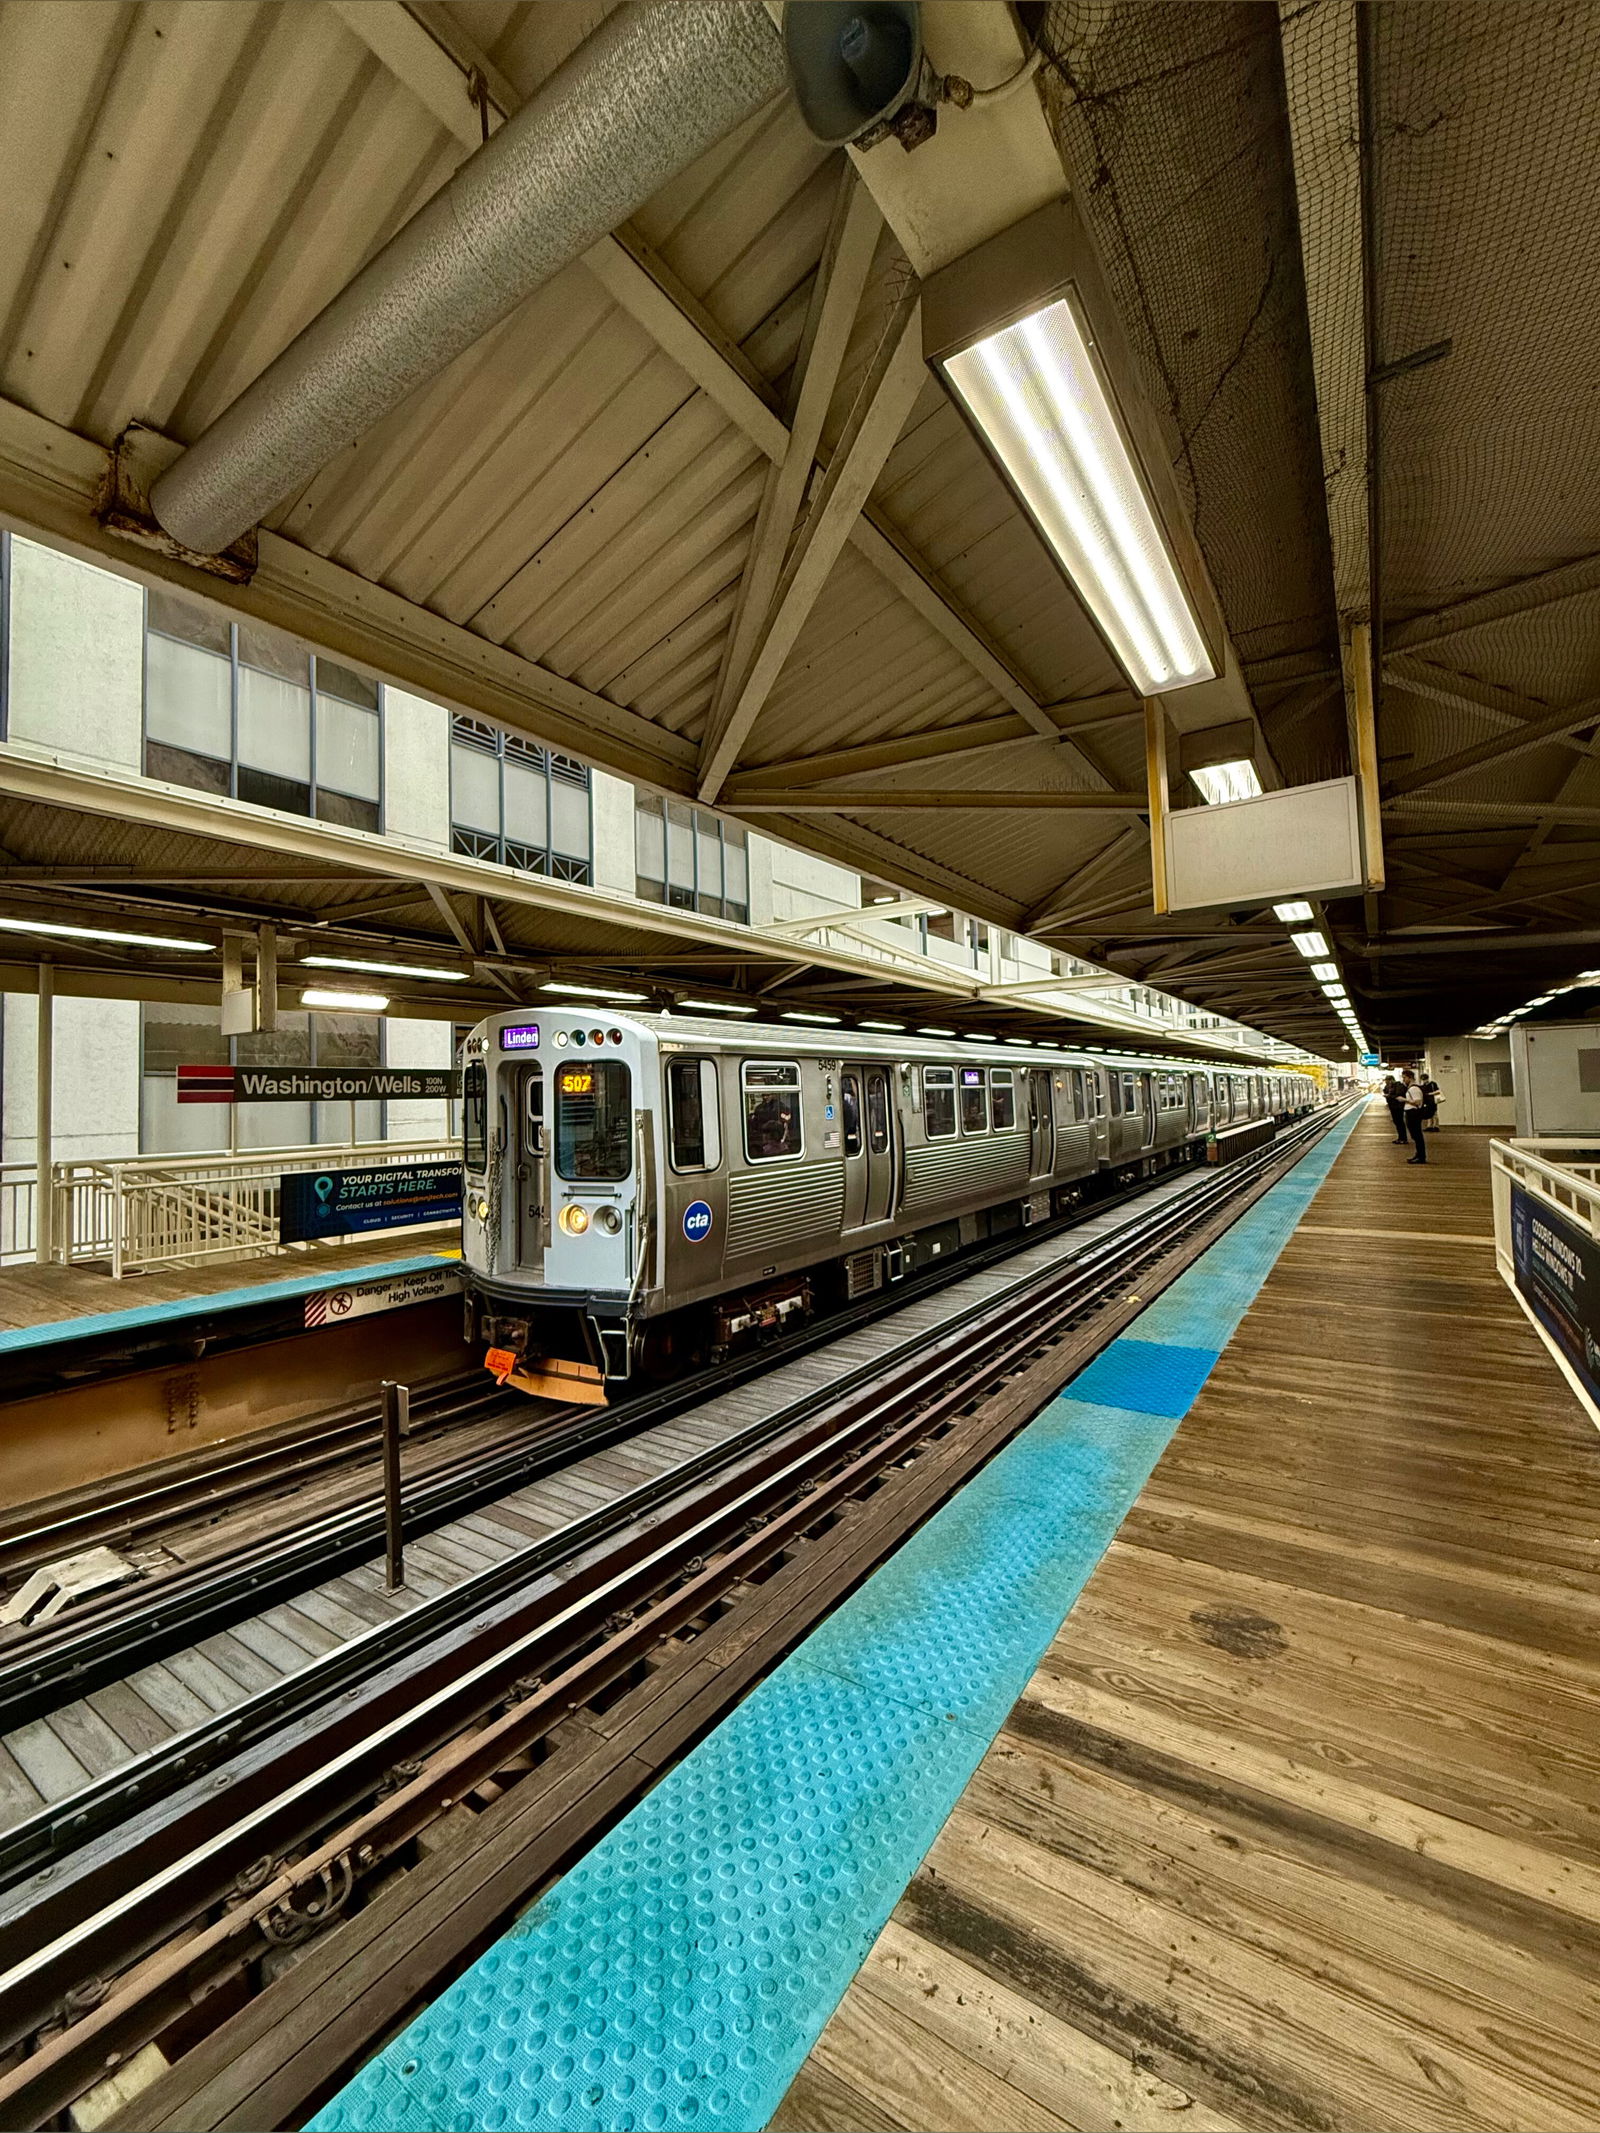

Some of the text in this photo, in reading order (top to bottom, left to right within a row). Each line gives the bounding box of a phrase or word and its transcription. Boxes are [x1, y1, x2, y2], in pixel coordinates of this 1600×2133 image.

[507, 1030, 538, 1045] Linden
[818, 1059, 836, 1071] 5459
[242, 1074, 422, 1099] Washington/Wells
[425, 1077, 443, 1085] 100N
[562, 1075, 592, 1092] 507
[424, 1085, 447, 1094] 200W
[1208, 1134, 1215, 1143] 2
[342, 1174, 372, 1185] YOUR
[374, 1171, 414, 1183] DIGITAL
[339, 1179, 437, 1199] STARTS HERE.
[335, 1202, 364, 1212] Contact
[686, 1212, 709, 1229] cta
[356, 1283, 393, 1297] Danger
[403, 1276, 427, 1288] Keep
[429, 1271, 443, 1282] Off
[388, 1283, 445, 1303] High Voltage
